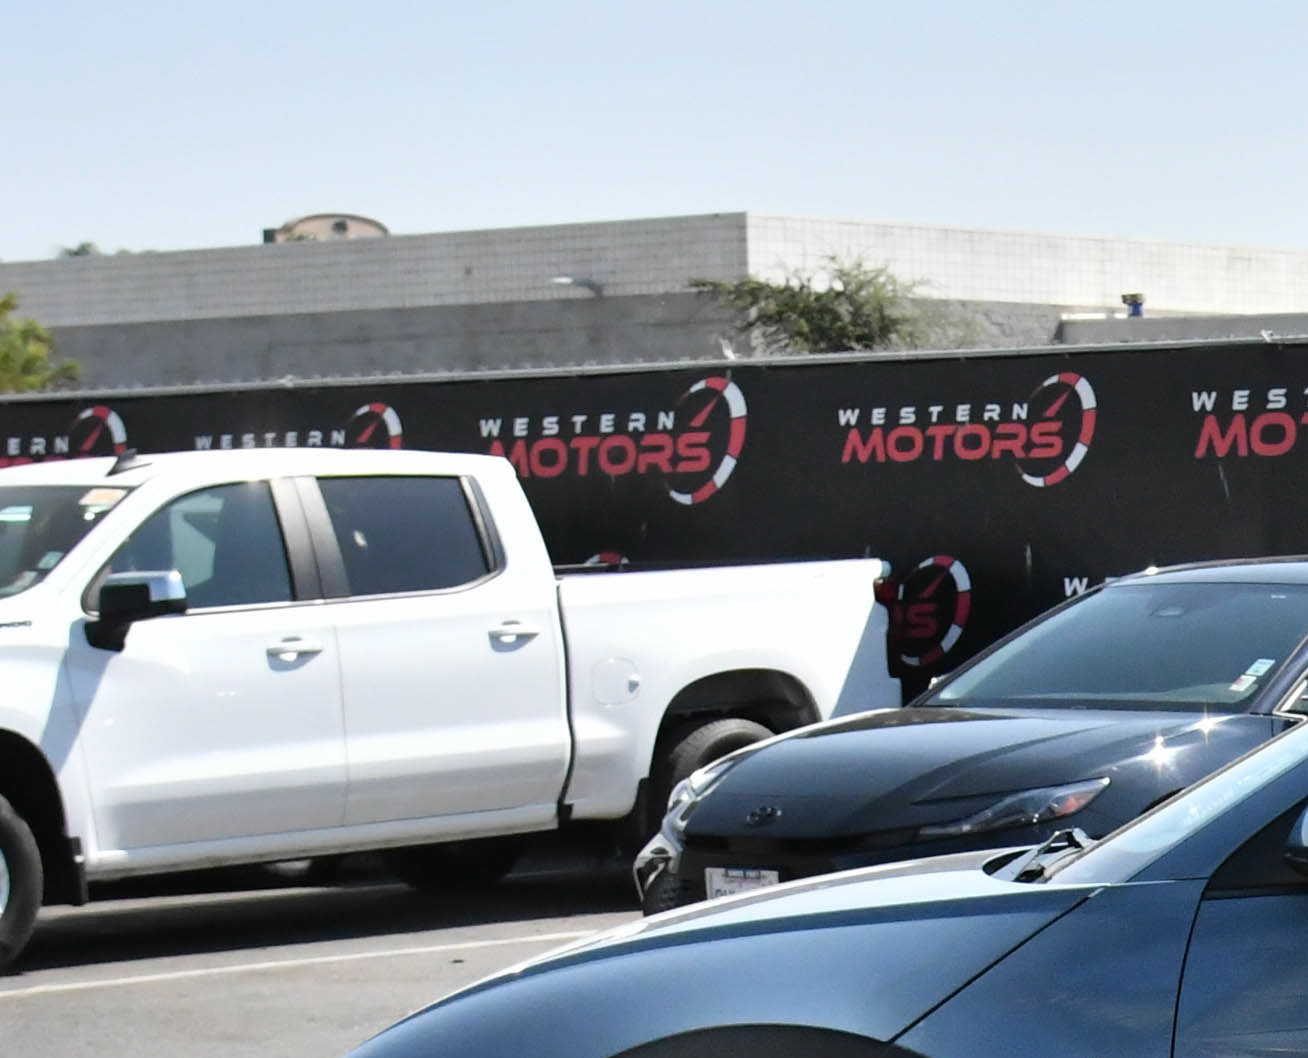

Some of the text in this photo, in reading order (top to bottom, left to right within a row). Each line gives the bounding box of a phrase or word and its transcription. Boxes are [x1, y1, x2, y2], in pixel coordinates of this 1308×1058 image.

[480, 411, 675, 437] WESTERN
[838, 403, 1028, 426] WESTERN
[194, 429, 346, 450] WESTERN
[841, 421, 1064, 463] MOTORS
